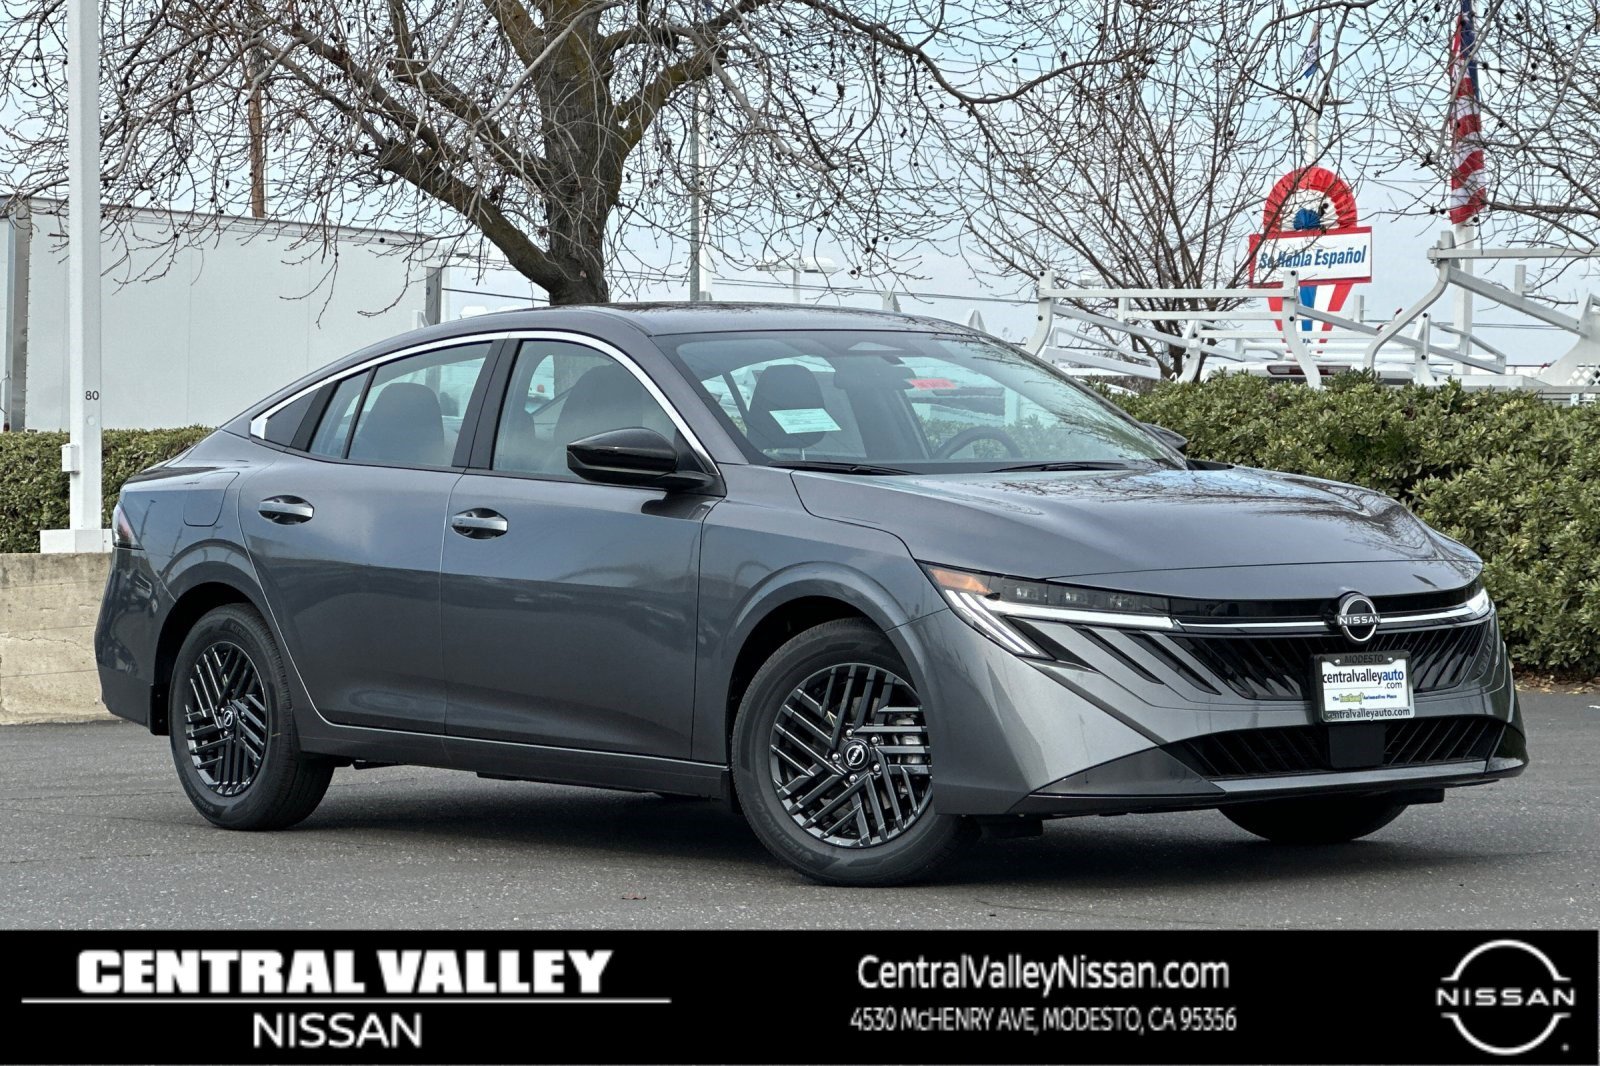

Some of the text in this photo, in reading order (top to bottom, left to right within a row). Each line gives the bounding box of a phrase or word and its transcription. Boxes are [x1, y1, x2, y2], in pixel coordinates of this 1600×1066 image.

[1314, 245, 1367, 269] Español
[85, 390, 99, 401] 80
[1339, 615, 1380, 625] NISSAN
[1344, 654, 1384, 664] MODESTO
[1327, 707, 1410, 719] centralvalleyauto.com
